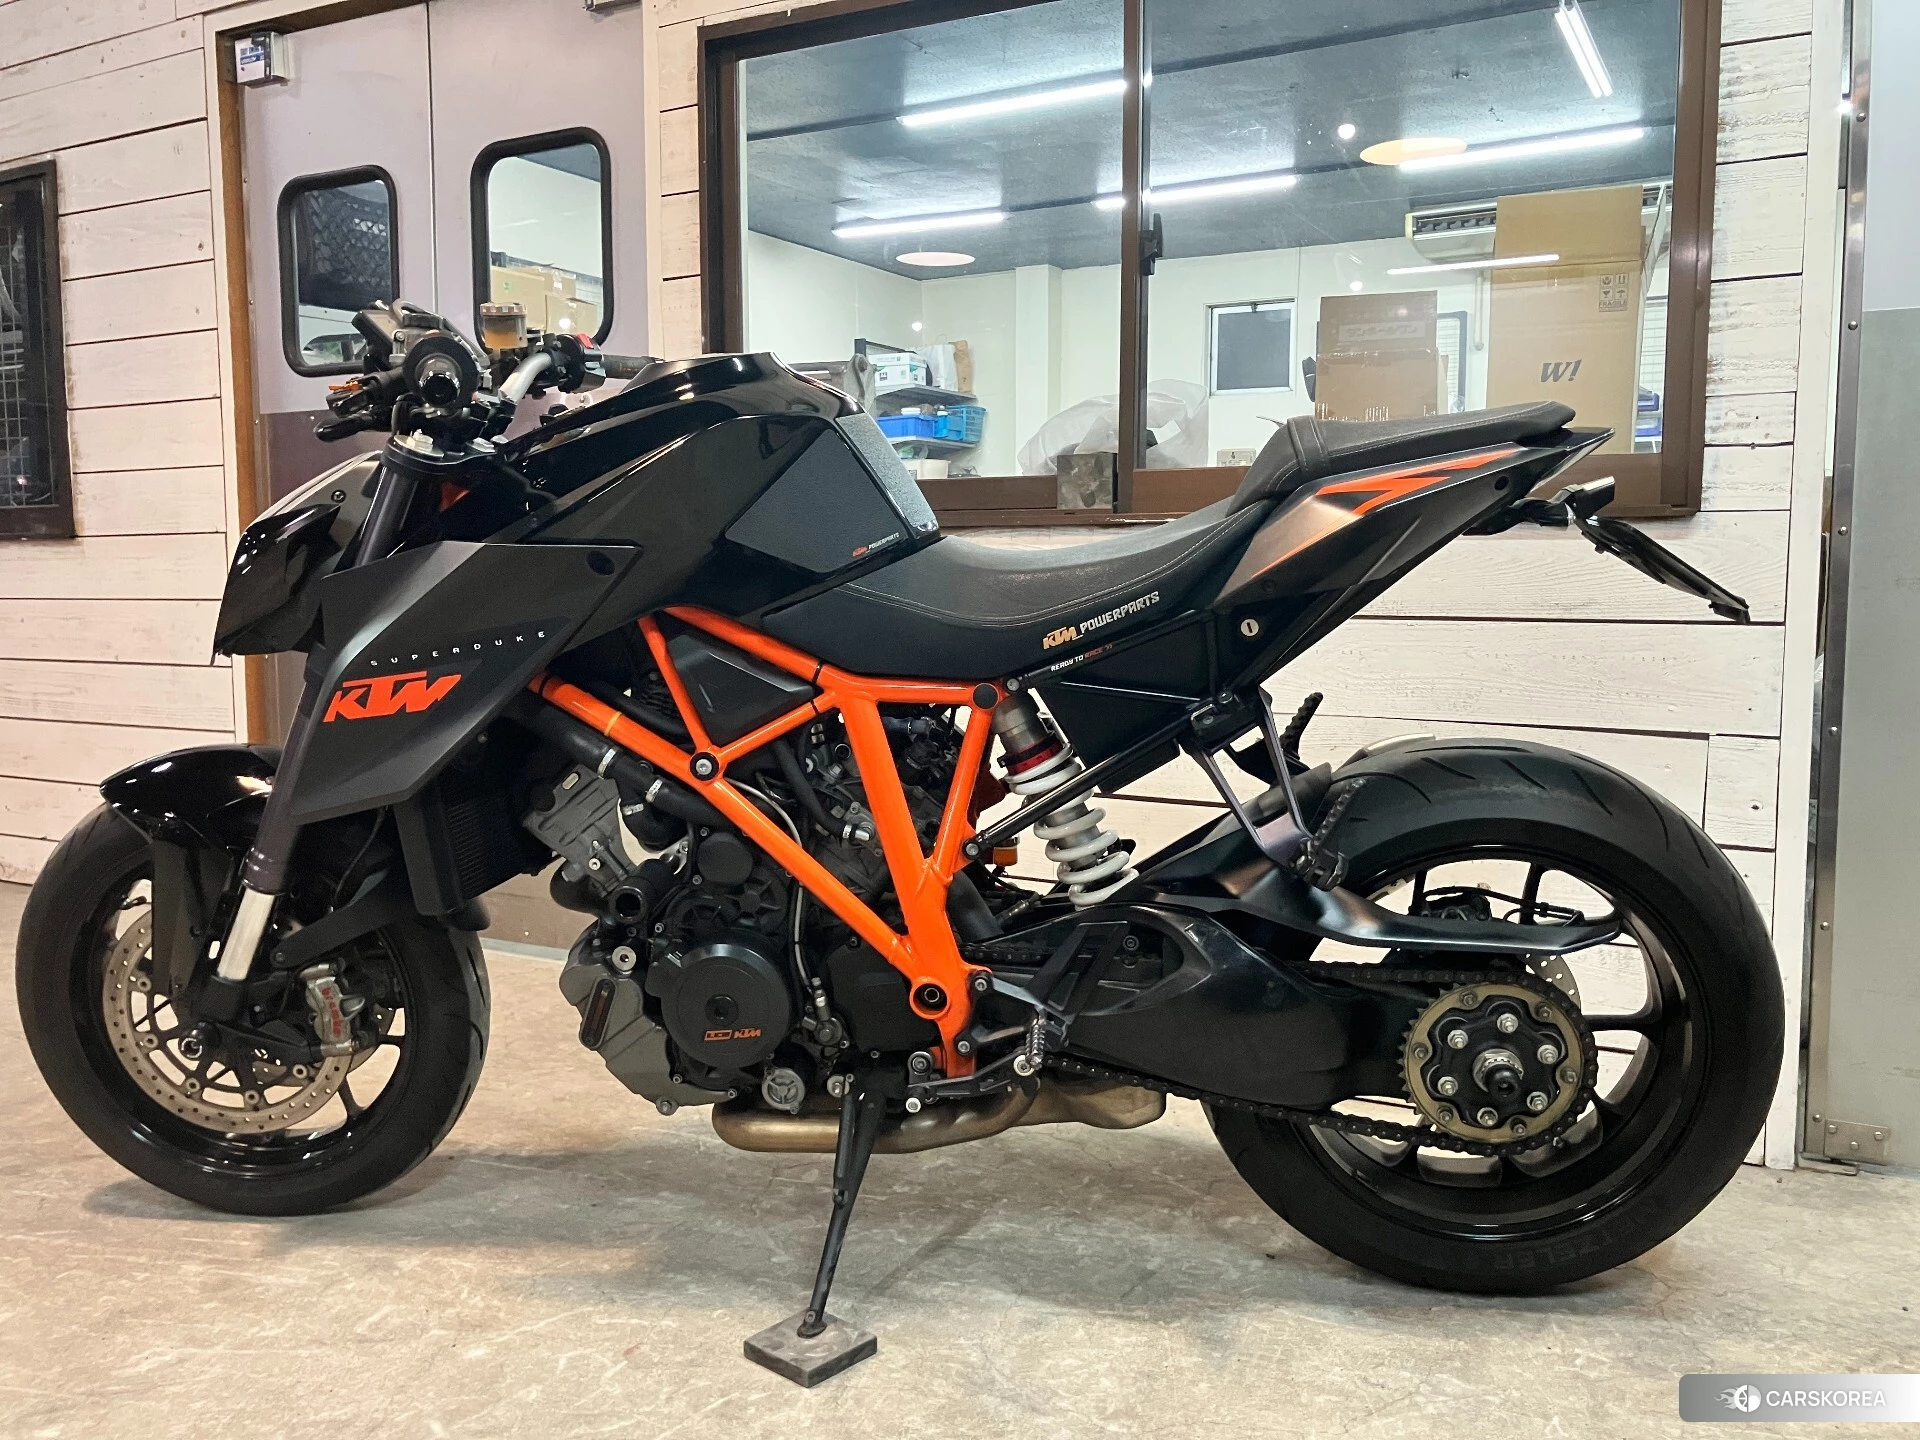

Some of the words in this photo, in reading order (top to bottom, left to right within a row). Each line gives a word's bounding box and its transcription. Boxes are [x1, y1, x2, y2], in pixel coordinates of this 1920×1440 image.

[1540, 359, 1582, 384] W!
[1042, 626, 1078, 650] KTM
[1080, 591, 1160, 633] POWERPARTS
[1050, 657, 1074, 671] READY
[1074, 654, 1084, 663] TO
[323, 671, 462, 722] KTM
[321, 986, 343, 1038] brembo
[734, 1028, 761, 1039] KTM
